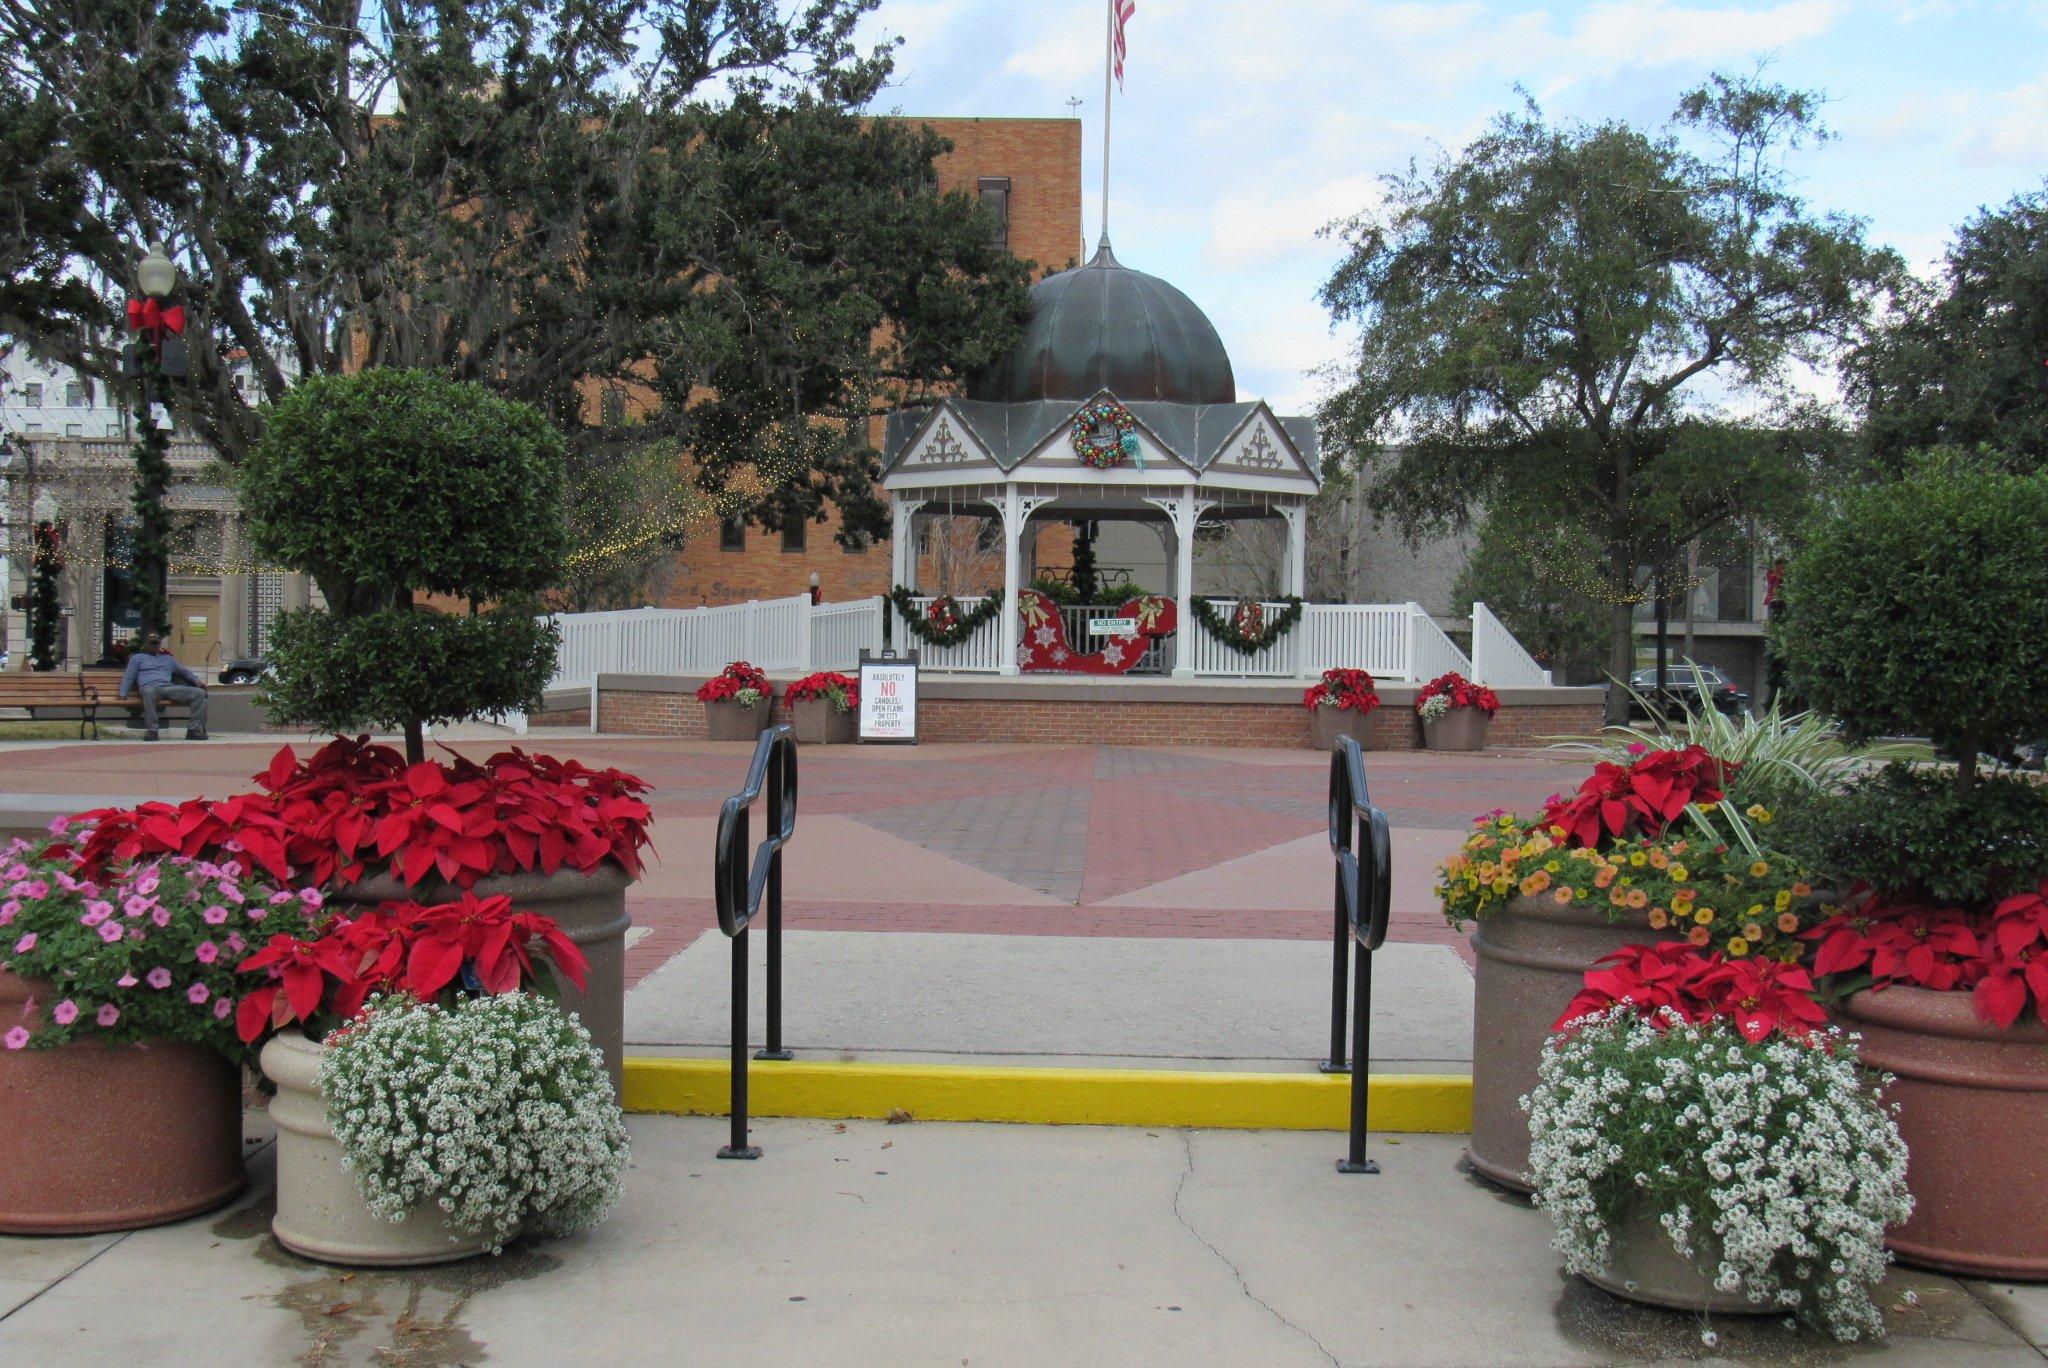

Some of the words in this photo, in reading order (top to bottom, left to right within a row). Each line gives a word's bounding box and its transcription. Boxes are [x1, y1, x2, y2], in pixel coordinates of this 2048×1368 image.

[873, 673, 905, 681] ABSOLUTELY
[880, 681, 896, 696] NO
[874, 697, 902, 705] CANDLES/
[877, 712, 885, 720] ON
[886, 712, 898, 720] CITY
